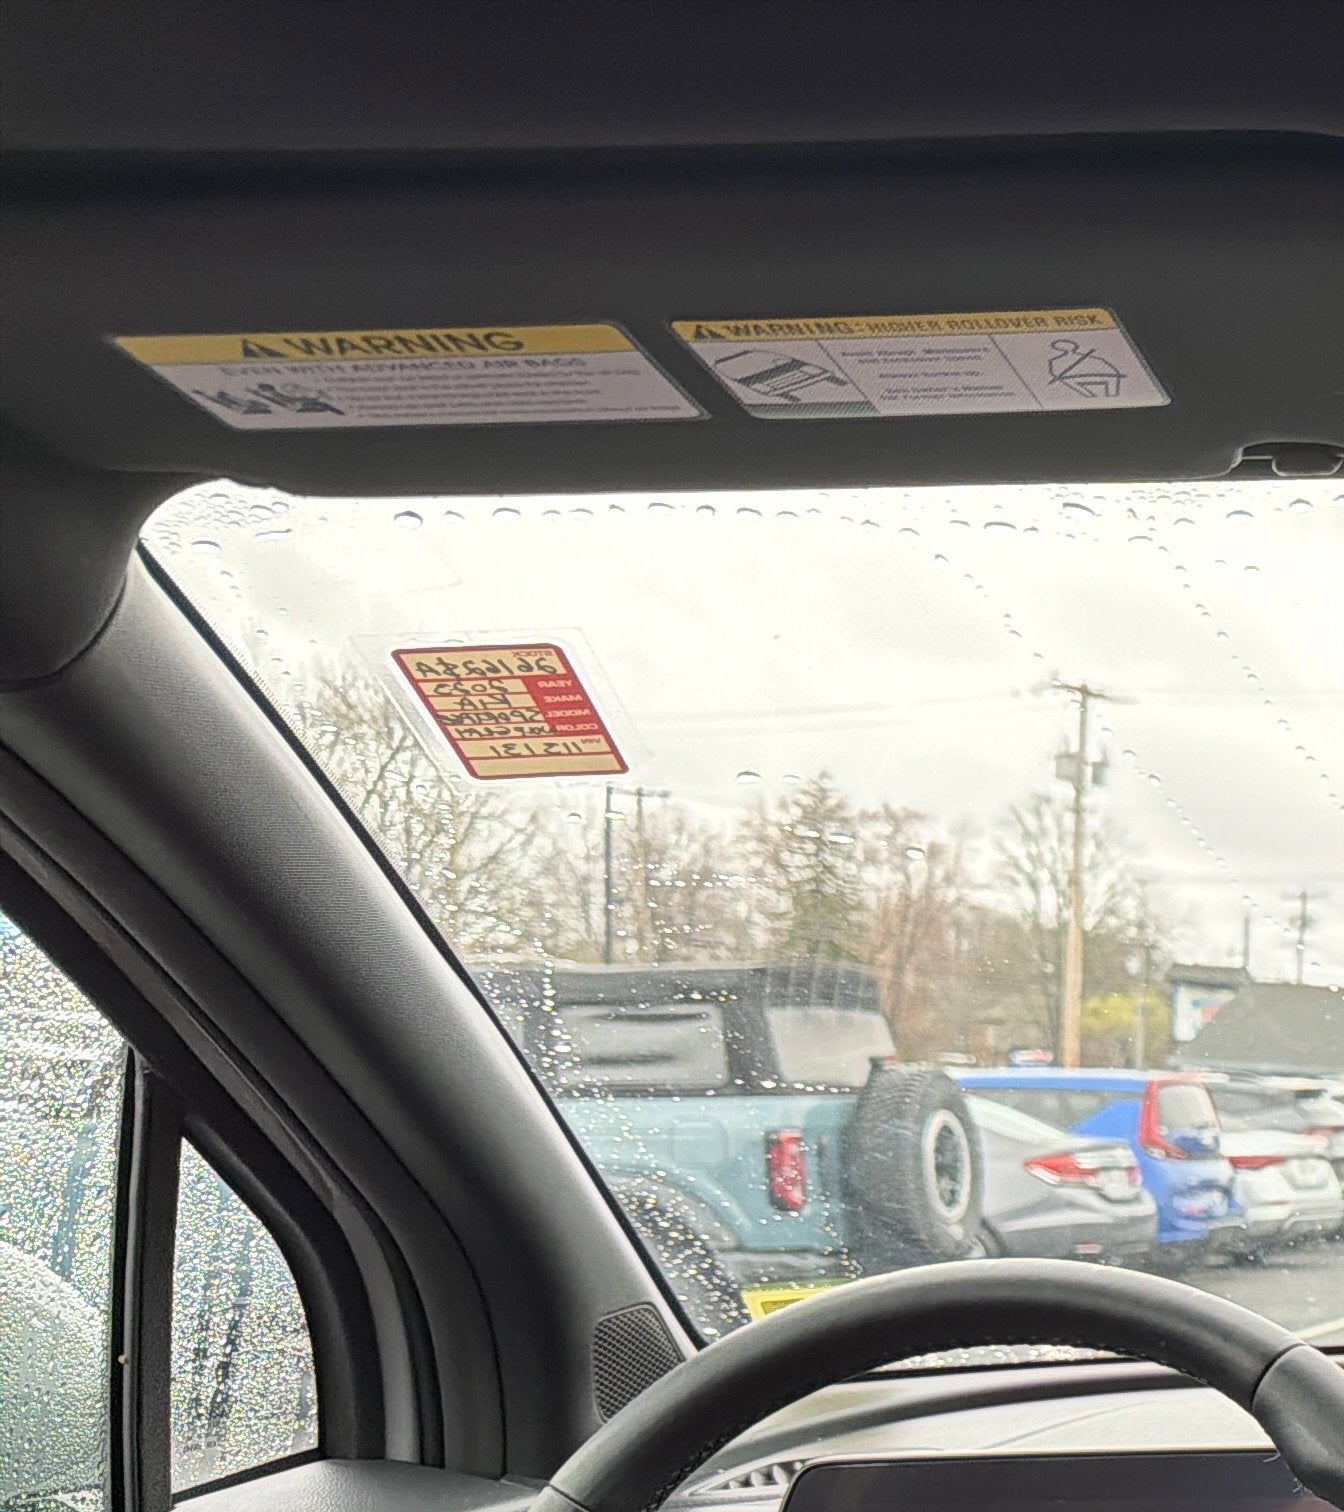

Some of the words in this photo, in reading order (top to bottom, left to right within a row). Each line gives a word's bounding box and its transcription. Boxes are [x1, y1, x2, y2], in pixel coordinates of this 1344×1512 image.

[869, 320, 943, 335] HIGHER
[947, 317, 1050, 332] ROLLOVER
[1053, 313, 1099, 328] RISK
[284, 331, 526, 357] WARNING
[352, 359, 476, 374] ADVANCED
